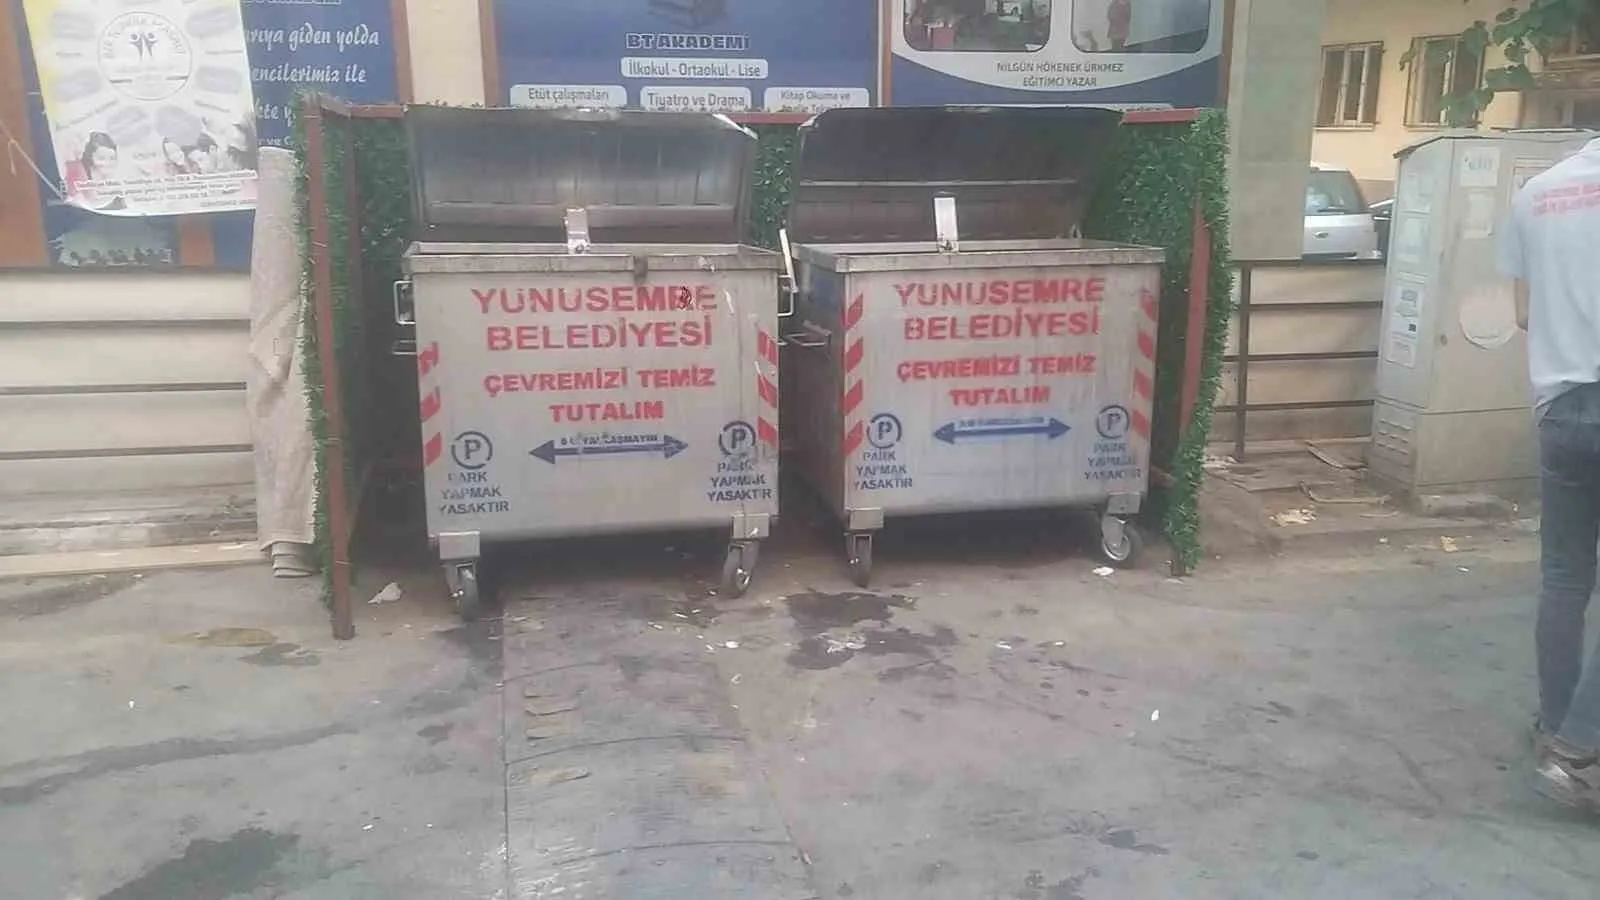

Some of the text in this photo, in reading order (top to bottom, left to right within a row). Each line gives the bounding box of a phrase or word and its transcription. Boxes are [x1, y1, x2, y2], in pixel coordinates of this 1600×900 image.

[288, 22, 331, 51] giden
[336, 23, 380, 52] yolda
[625, 32, 750, 50] BT AKADEMİ
[344, 63, 367, 83] ile
[628, 59, 670, 75] İlkokul
[678, 62, 728, 77] Ortaokul
[738, 63, 761, 77] Lise
[1066, 76, 1097, 88] YAZAR
[528, 87, 551, 101] Etüt
[647, 91, 746, 110] Tiyatro ve Drama
[892, 278, 1106, 306] YUNUSEMRE
[486, 315, 713, 351] BELEDİYESİ
[904, 307, 1100, 341] BELEDİYESİ
[896, 353, 1096, 382] ÇEVREMİZİ TEMİZ
[484, 364, 717, 398] ÇEVREMİZİ TEMİZ
[949, 386, 1051, 407] TUTALIM
[548, 400, 664, 423] TUTALIM
[863, 450, 896, 461] PARK
[856, 464, 907, 476] YAPMAK
[854, 478, 913, 490] YASAKTIR
[707, 488, 772, 502] YASAKTR
[438, 501, 510, 515] YASAKTIR
